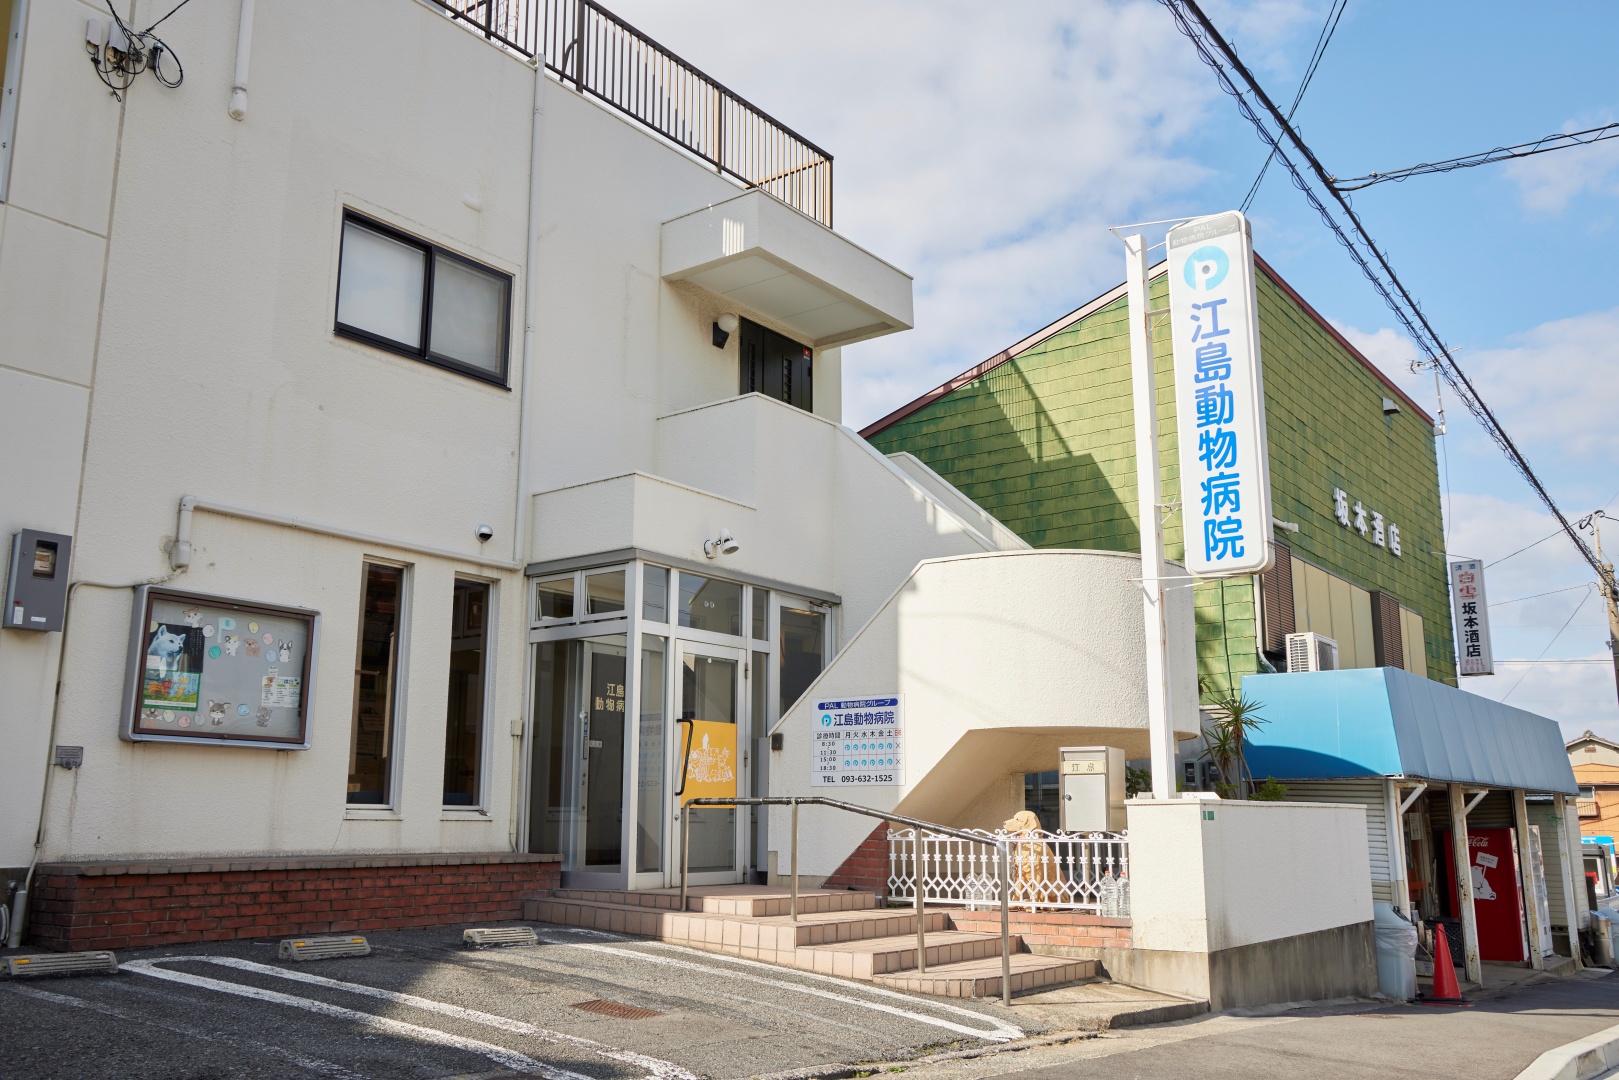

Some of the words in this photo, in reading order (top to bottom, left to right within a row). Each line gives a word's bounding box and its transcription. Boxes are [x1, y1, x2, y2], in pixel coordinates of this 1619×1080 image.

[1172, 224, 1236, 247] 動物病院グループ
[1194, 223, 1212, 233] PAL
[1190, 298, 1245, 562] 江島動物病院
[1332, 487, 1402, 558] 坂本酒店
[1462, 601, 1482, 658] 坂本酒店
[606, 683, 625, 698] 江島
[840, 699, 891, 709] 動物病院グループ
[833, 711, 895, 726] 江島動物病院
[816, 732, 841, 740] 診療時間
[844, 731, 851, 739] 月
[869, 730, 876, 738] 木
[877, 729, 884, 737] 金
[886, 729, 893, 737] 土
[1071, 762, 1095, 772] 江島
[823, 775, 836, 783] TEL
[841, 774, 893, 783] 093-632-1525
